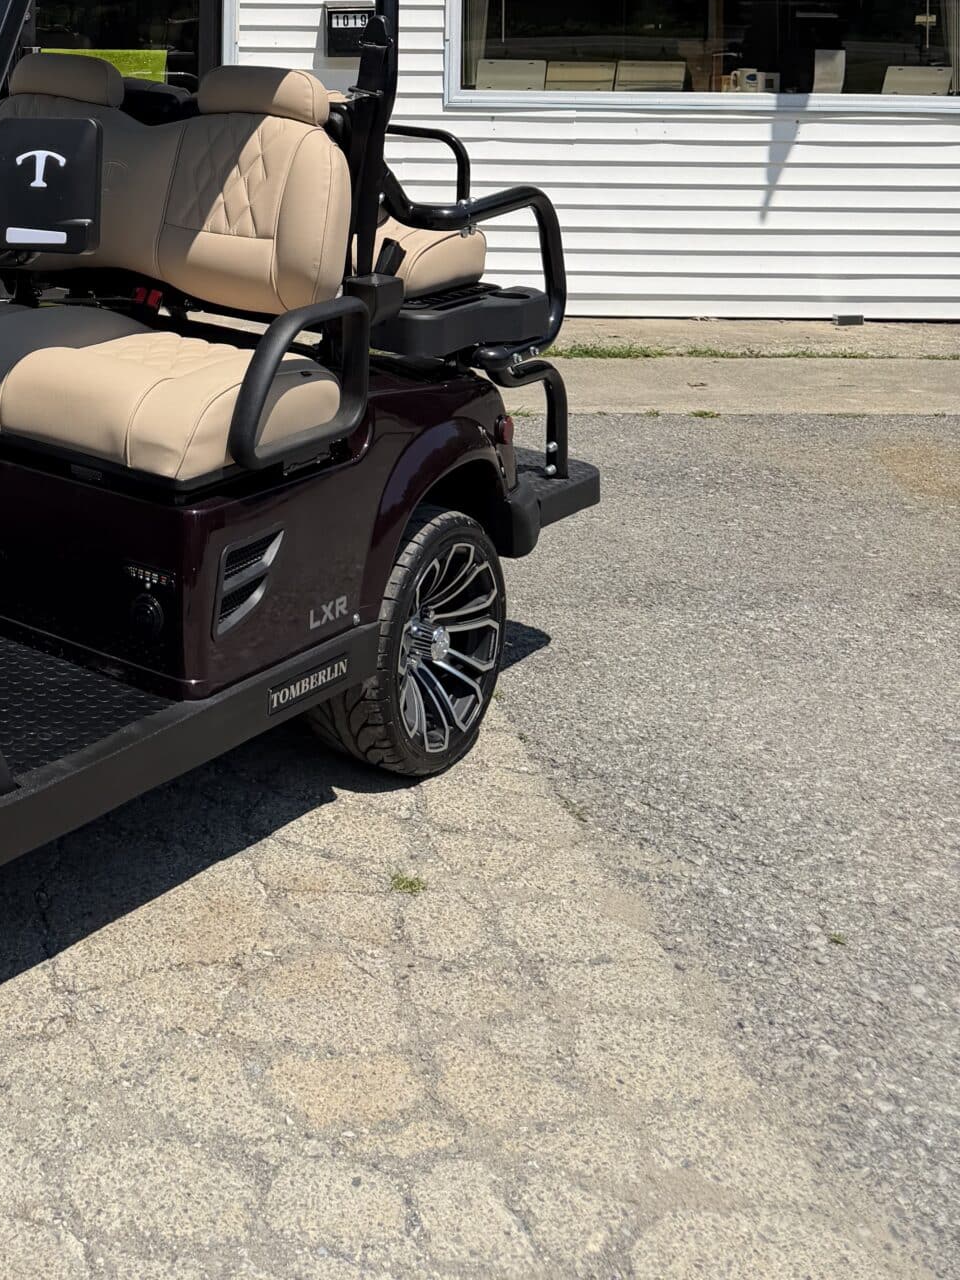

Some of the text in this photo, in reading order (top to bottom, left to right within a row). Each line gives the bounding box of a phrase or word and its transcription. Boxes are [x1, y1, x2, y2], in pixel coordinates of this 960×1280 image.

[334, 15, 367, 26] 1019
[309, 594, 349, 630] LXR
[270, 658, 348, 709] TOMBERLIN
